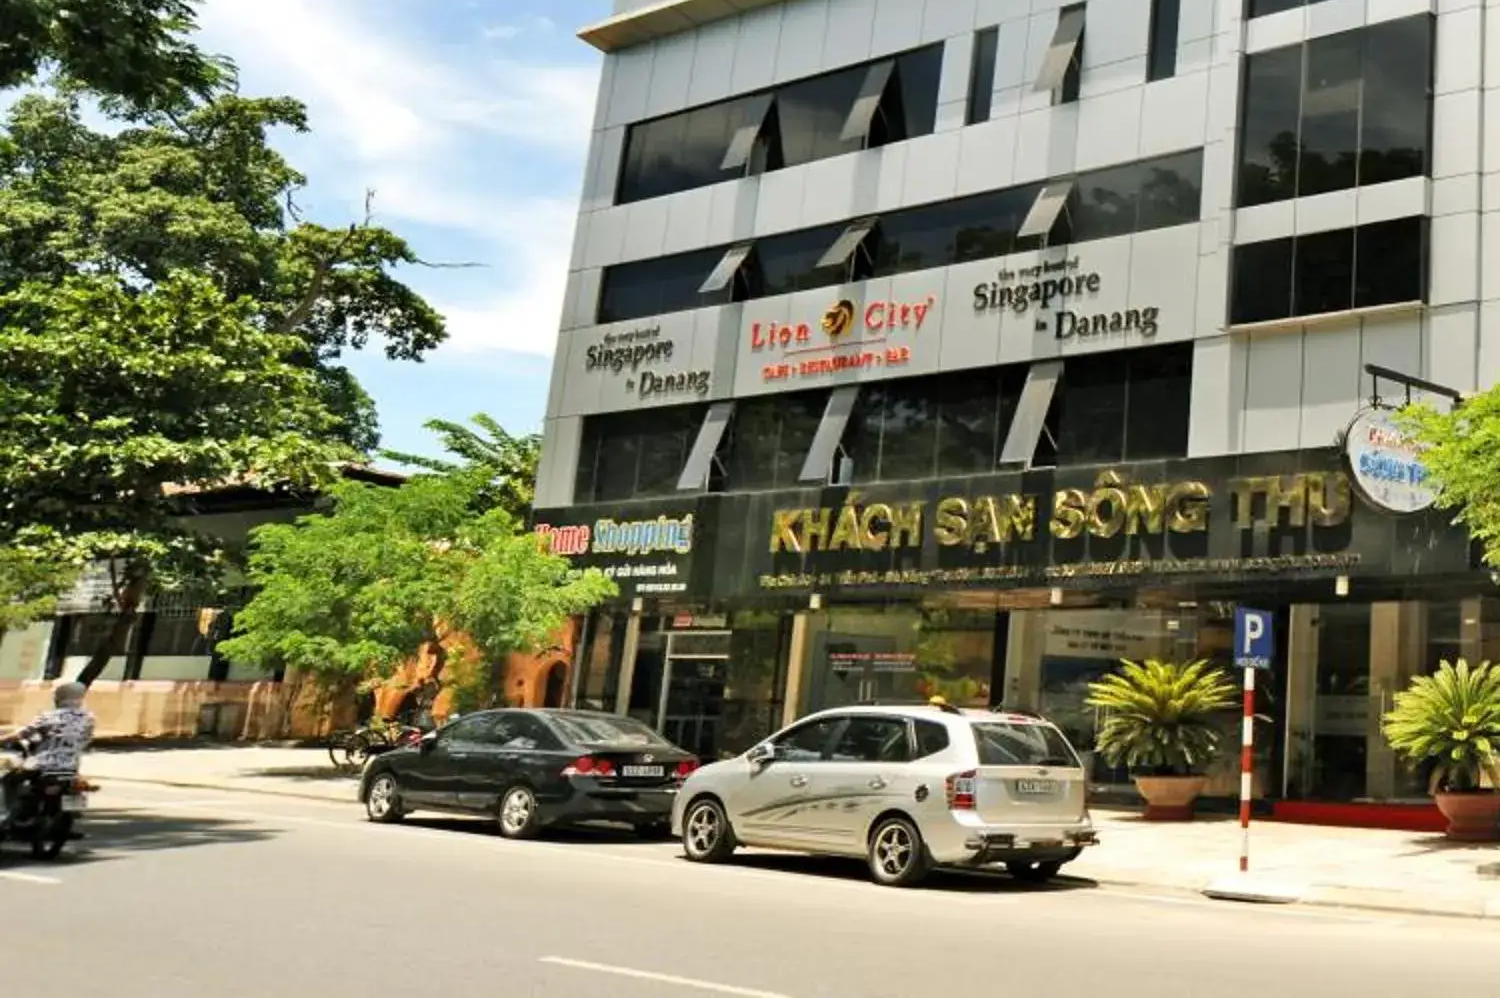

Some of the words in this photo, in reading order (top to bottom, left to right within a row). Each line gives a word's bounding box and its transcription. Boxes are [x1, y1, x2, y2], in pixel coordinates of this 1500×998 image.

[973, 270, 1100, 311] Singapore
[752, 316, 811, 349] Lion
[864, 301, 929, 332] City
[1055, 306, 1160, 340] Danang
[586, 339, 674, 373] Singapore
[639, 370, 710, 397] Danang
[768, 491, 927, 553] KHÁCH
[934, 492, 1037, 554] SẠN
[1049, 469, 1213, 539] SÔNG
[1230, 471, 1351, 528] THU
[592, 513, 693, 555] Shopping
[1244, 613, 1264, 655] P
